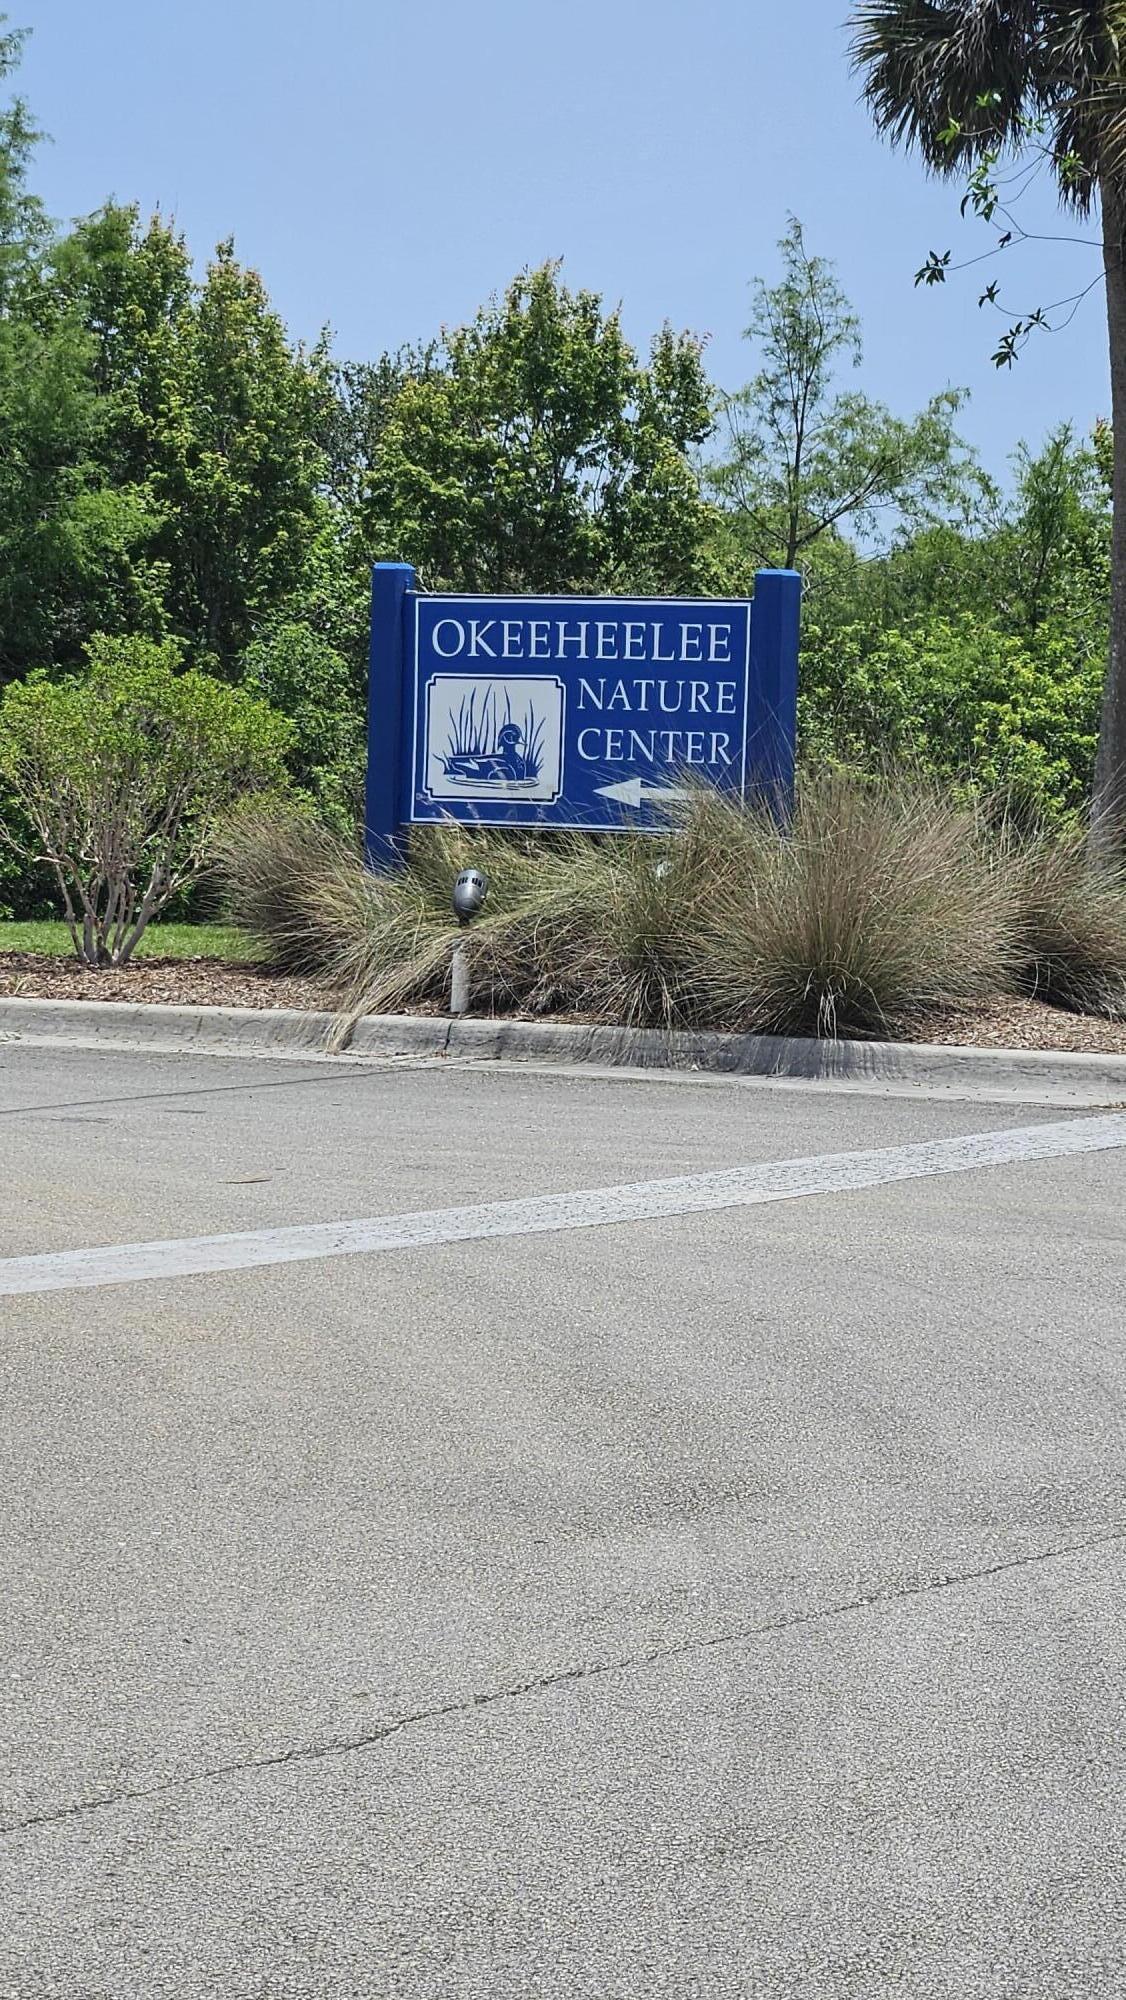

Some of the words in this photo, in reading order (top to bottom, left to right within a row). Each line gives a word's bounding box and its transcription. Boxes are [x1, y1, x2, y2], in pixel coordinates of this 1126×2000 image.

[432, 619, 732, 662] OKEEHEELEE
[576, 678, 737, 714] NATURE
[576, 728, 733, 765] CENTER
